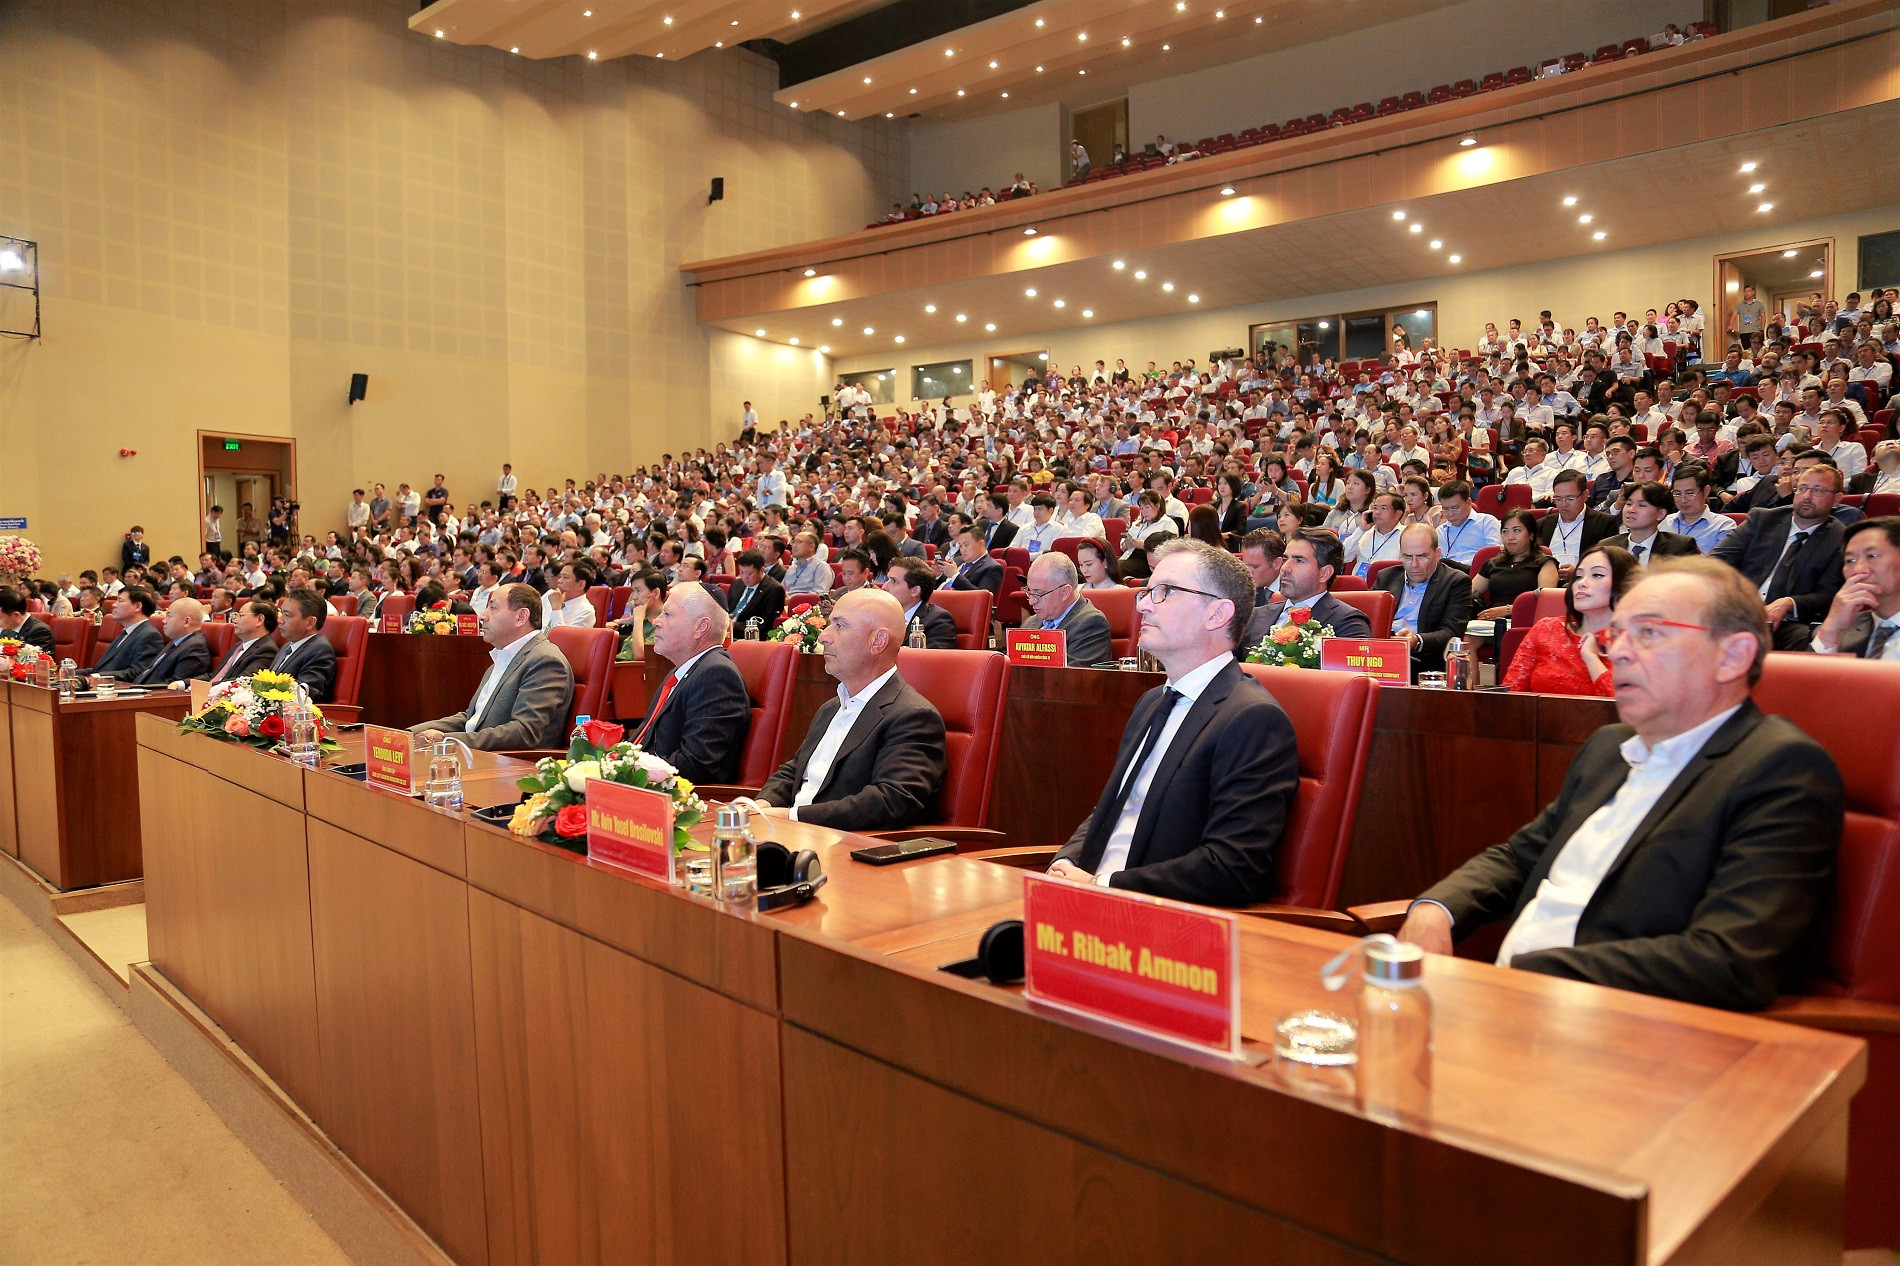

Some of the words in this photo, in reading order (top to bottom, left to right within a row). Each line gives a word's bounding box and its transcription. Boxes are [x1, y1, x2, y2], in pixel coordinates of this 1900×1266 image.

[1346, 656, 1365, 667] THUY
[1367, 657, 1382, 667] NGO
[1036, 922, 1068, 956] Mr.
[1073, 931, 1133, 973] Ribak
[1138, 947, 1218, 995] Amnon
